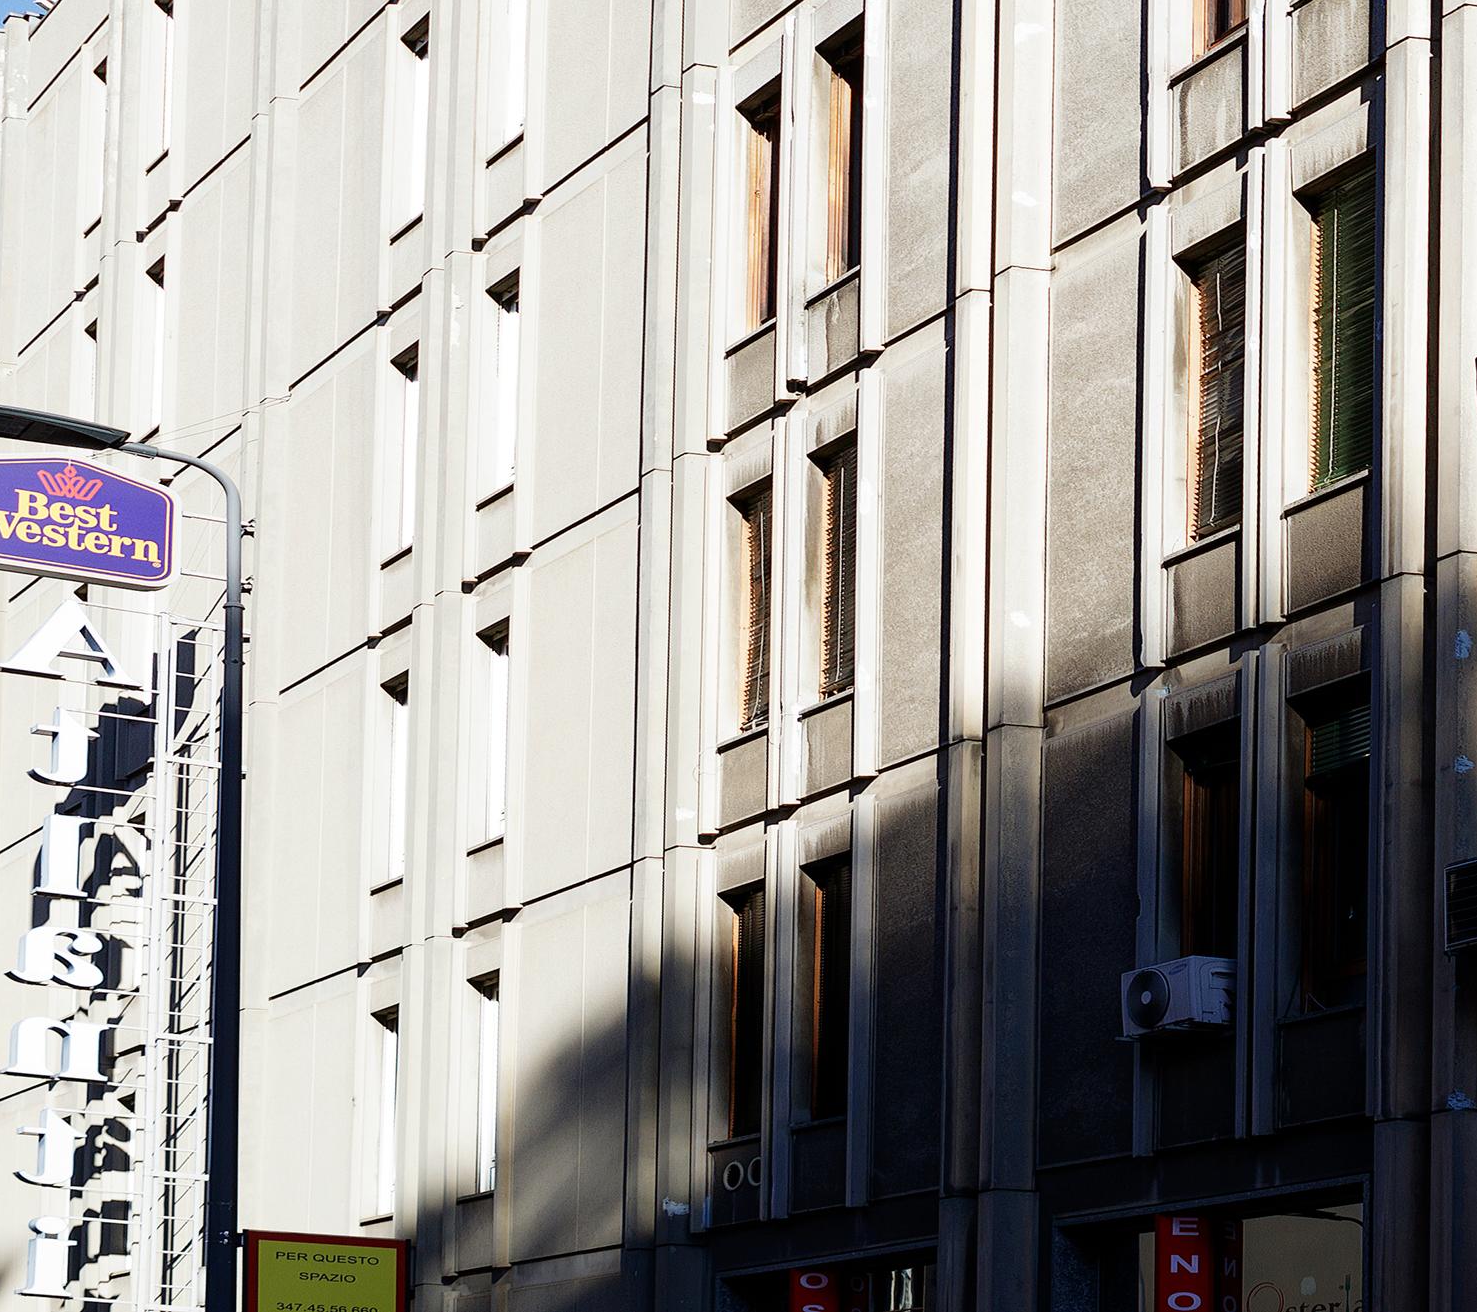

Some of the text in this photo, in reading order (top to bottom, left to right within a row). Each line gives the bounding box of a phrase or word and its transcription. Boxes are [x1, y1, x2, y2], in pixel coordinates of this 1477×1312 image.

[14, 487, 118, 532] Best
[276, 1251, 379, 1265] PER QUESTO
[1167, 1217, 1202, 1312] ENO
[299, 1272, 356, 1283] SPAZIO
[276, 1303, 378, 1312] 347.45.56660
